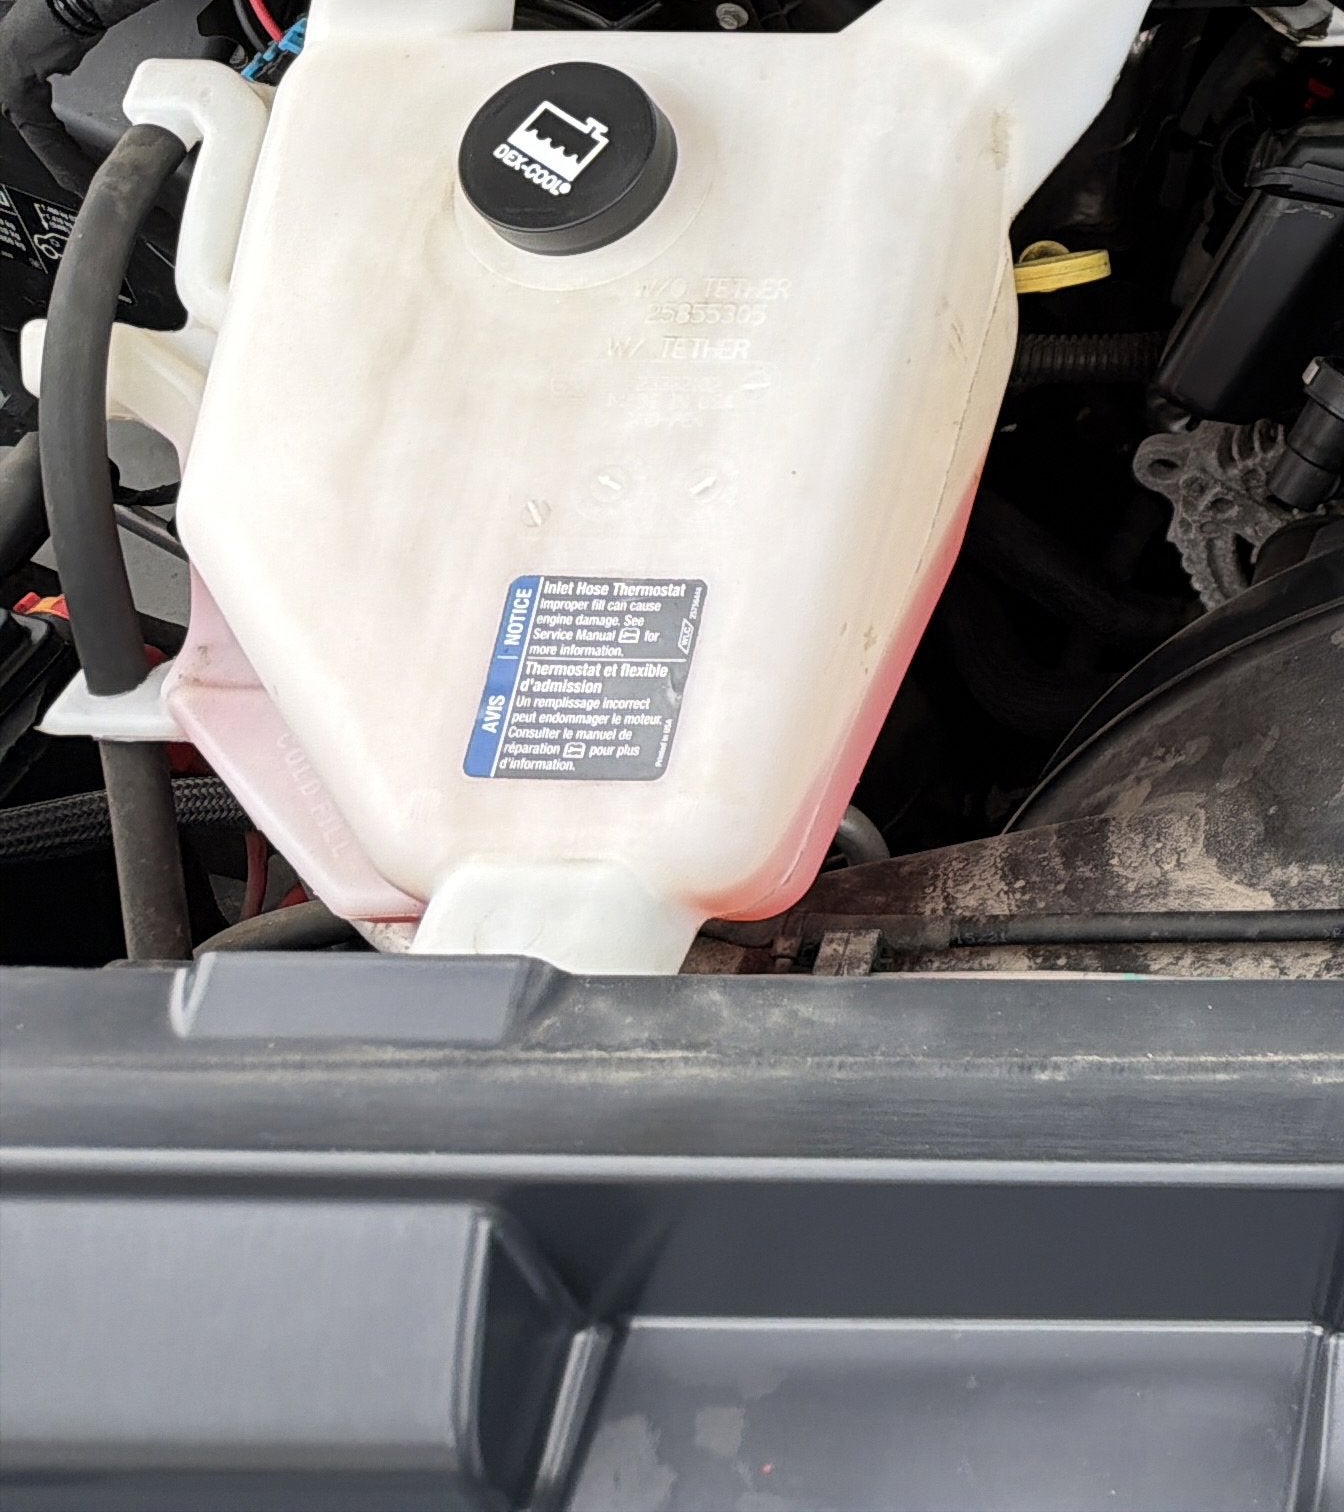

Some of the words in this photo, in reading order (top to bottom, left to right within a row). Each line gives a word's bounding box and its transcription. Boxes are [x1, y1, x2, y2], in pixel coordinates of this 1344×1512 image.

[544, 580, 573, 595] Inlet
[576, 581, 609, 596] Hose
[612, 582, 686, 597] Thermostat
[539, 598, 589, 612] Improper
[591, 599, 605, 611] fill
[607, 601, 627, 611] can
[629, 602, 662, 612] cause
[503, 587, 533, 646] NOTICE
[536, 614, 572, 626] engine
[575, 614, 620, 627] damage.
[624, 615, 645, 627] See
[532, 628, 573, 640] Service
[575, 630, 617, 642] Manual
[643, 630, 661, 642] for
[529, 645, 557, 656] more
[560, 644, 624, 657] information.
[525, 661, 602, 677] Thermostat
[603, 663, 617, 677] et
[620, 663, 669, 678] flexible
[519, 679, 603, 694] d'admission
[515, 695, 532, 707] Un
[533, 696, 600, 711] remplissage
[602, 697, 650, 710] incorrect
[481, 694, 506, 734] AVIS
[511, 712, 537, 725] peut
[538, 713, 610, 727] endommager
[612, 713, 622, 725] le
[624, 714, 662, 725] moteur.
[507, 726, 560, 739] Consulter
[563, 727, 573, 739] le
[576, 728, 617, 740] manuel
[618, 728, 633, 741] de
[503, 742, 560, 757] réparation
[589, 746, 614, 758] pour
[616, 745, 640, 758] plus
[499, 758, 576, 772] d'information.
